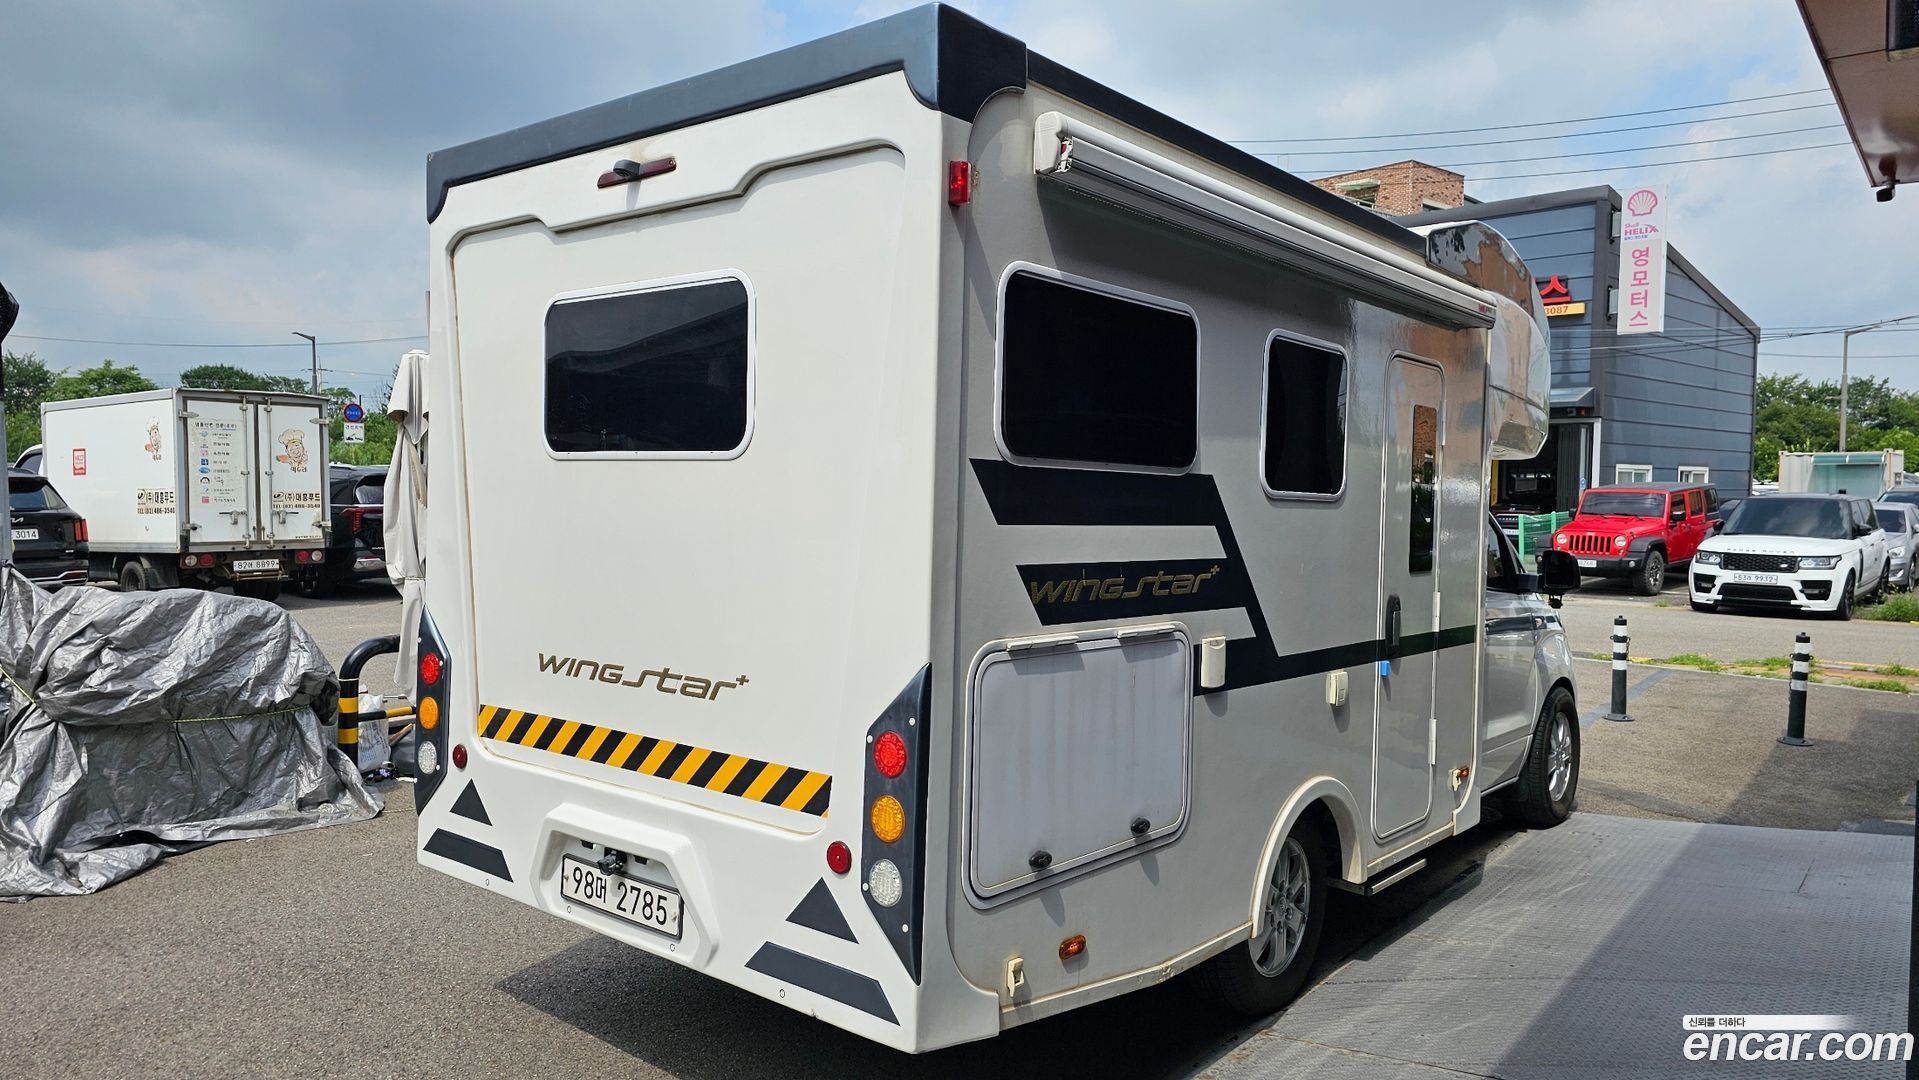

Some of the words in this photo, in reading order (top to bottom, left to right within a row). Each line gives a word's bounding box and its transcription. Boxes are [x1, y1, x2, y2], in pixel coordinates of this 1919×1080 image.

[1624, 225, 1659, 236] HELIX
[1629, 246, 1650, 327] 영모터스
[572, 866, 607, 904] 98머
[616, 881, 668, 926] 2785
